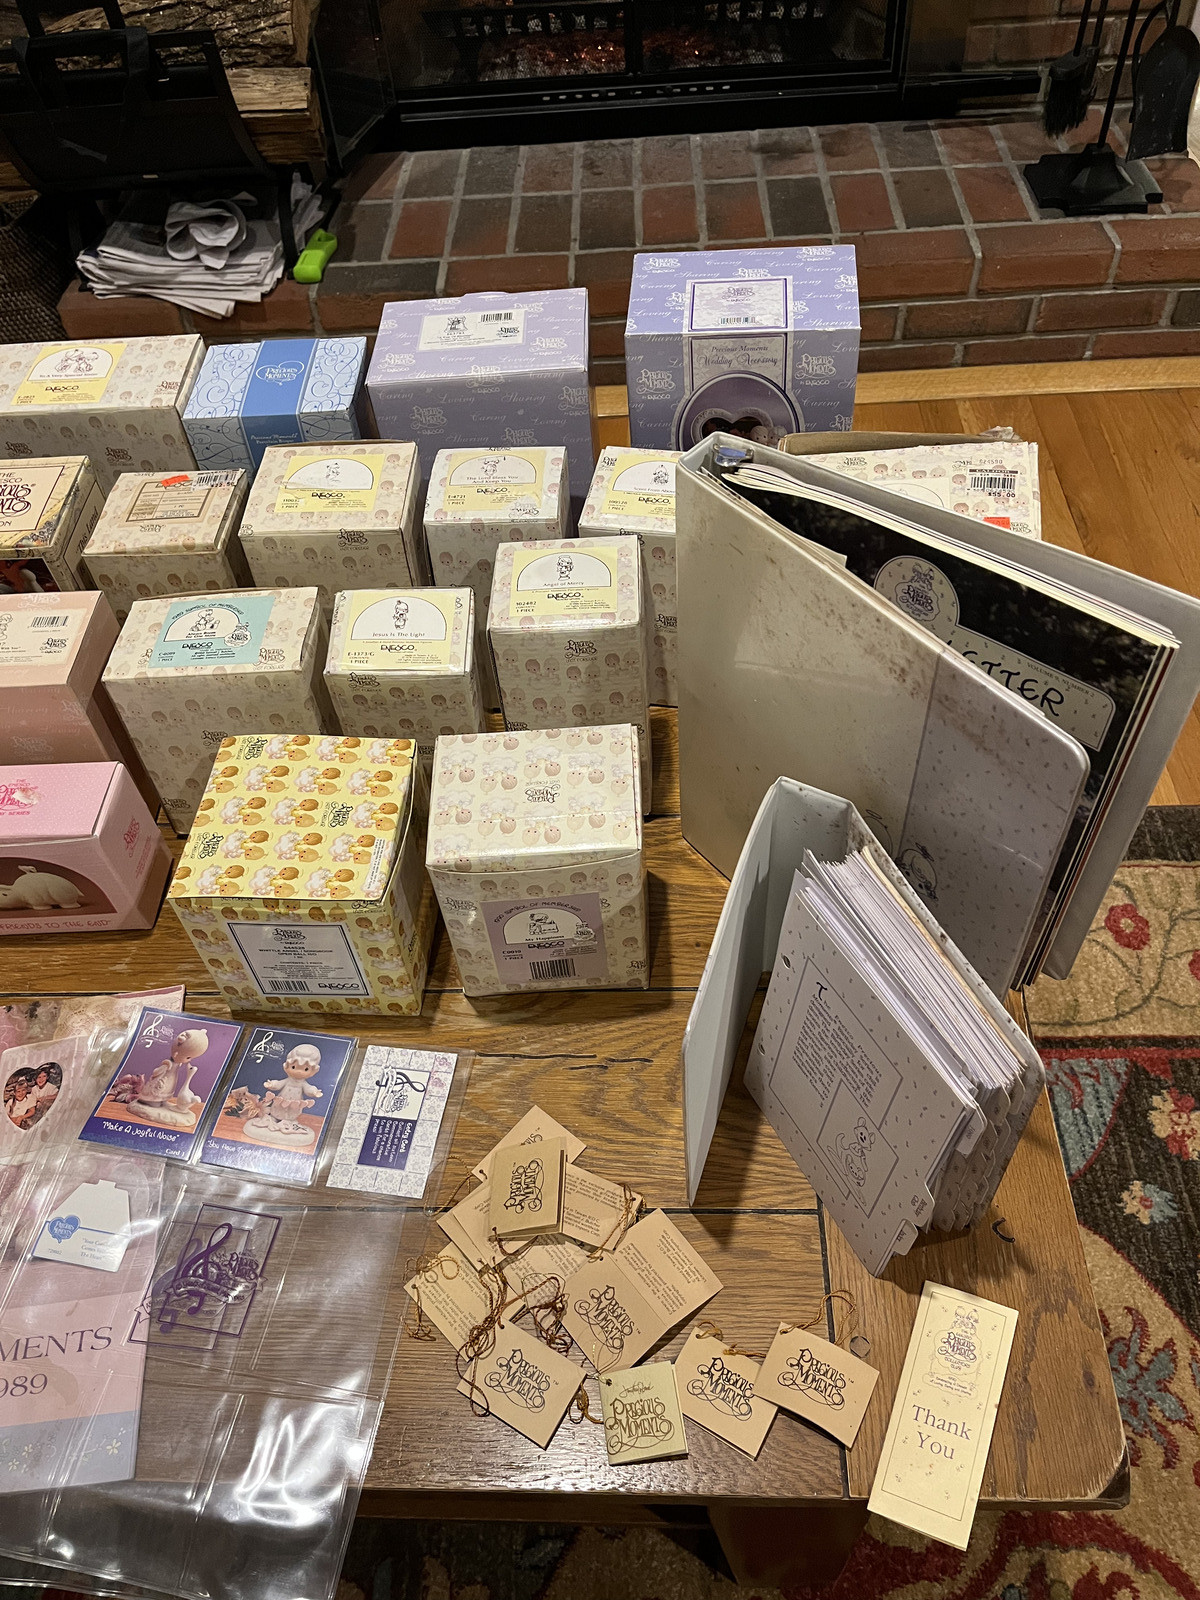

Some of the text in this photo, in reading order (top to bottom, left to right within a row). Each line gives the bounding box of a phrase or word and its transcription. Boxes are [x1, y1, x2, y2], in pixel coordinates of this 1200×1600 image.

[697, 353, 779, 367] Wedding Accessory
[711, 345, 768, 354] Precious Moments
[547, 592, 581, 600] ENESCO
[131, 1126, 157, 1139] Joyful
[399, 1122, 413, 1153] Entry Card
[583, 1300, 625, 1352] Moments
[604, 1284, 634, 1336] Precious
[0, 1327, 112, 1361] MENTS
[509, 1349, 551, 1391] Precious
[708, 1357, 754, 1400] Precious
[784, 1356, 846, 1410] Moments
[799, 1348, 847, 1391] Precious
[490, 1366, 547, 1412] Moments
[611, 1397, 666, 1417] Precious
[694, 1364, 753, 1419] Moments
[610, 1414, 675, 1442] Moments
[911, 1403, 973, 1441] Thank
[917, 1431, 956, 1461] You
